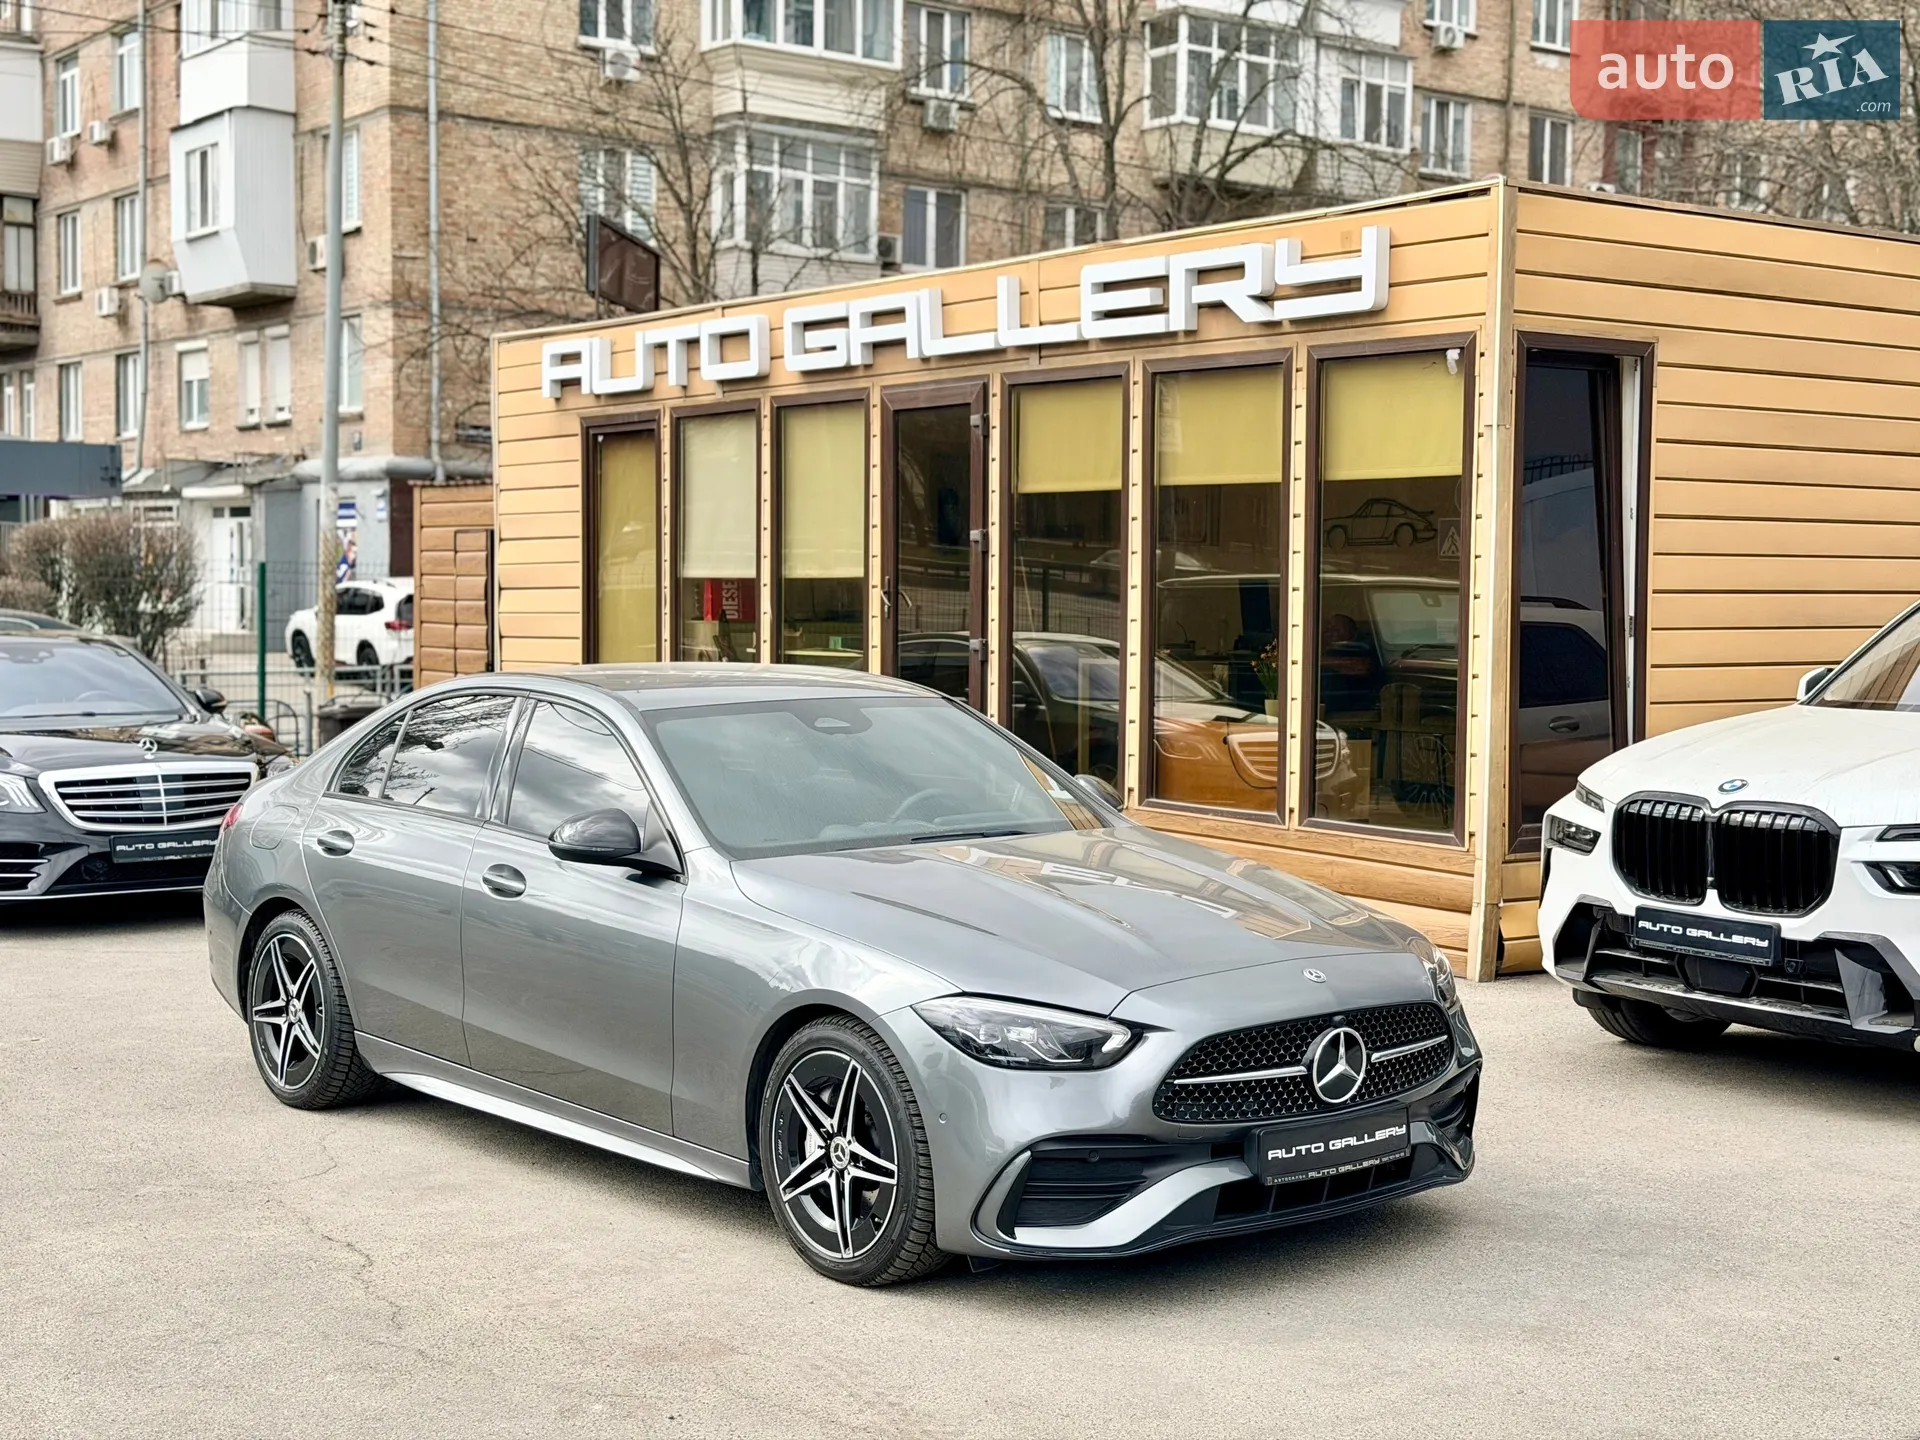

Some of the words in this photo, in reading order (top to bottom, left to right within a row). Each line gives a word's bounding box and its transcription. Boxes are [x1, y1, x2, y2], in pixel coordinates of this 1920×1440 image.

[541, 314, 770, 399] AUTO
[783, 225, 1391, 372] GALLERY
[722, 580, 739, 619] DIESE
[116, 843, 154, 851] AUTO
[1638, 920, 1683, 934] AUTO
[1685, 927, 1769, 948] GALLERY
[1267, 1142, 1325, 1161] AUTO
[1328, 1124, 1406, 1150] GALLERY
[1308, 1167, 1337, 1178] AUTO
[1338, 1158, 1380, 1173] GALLERY
